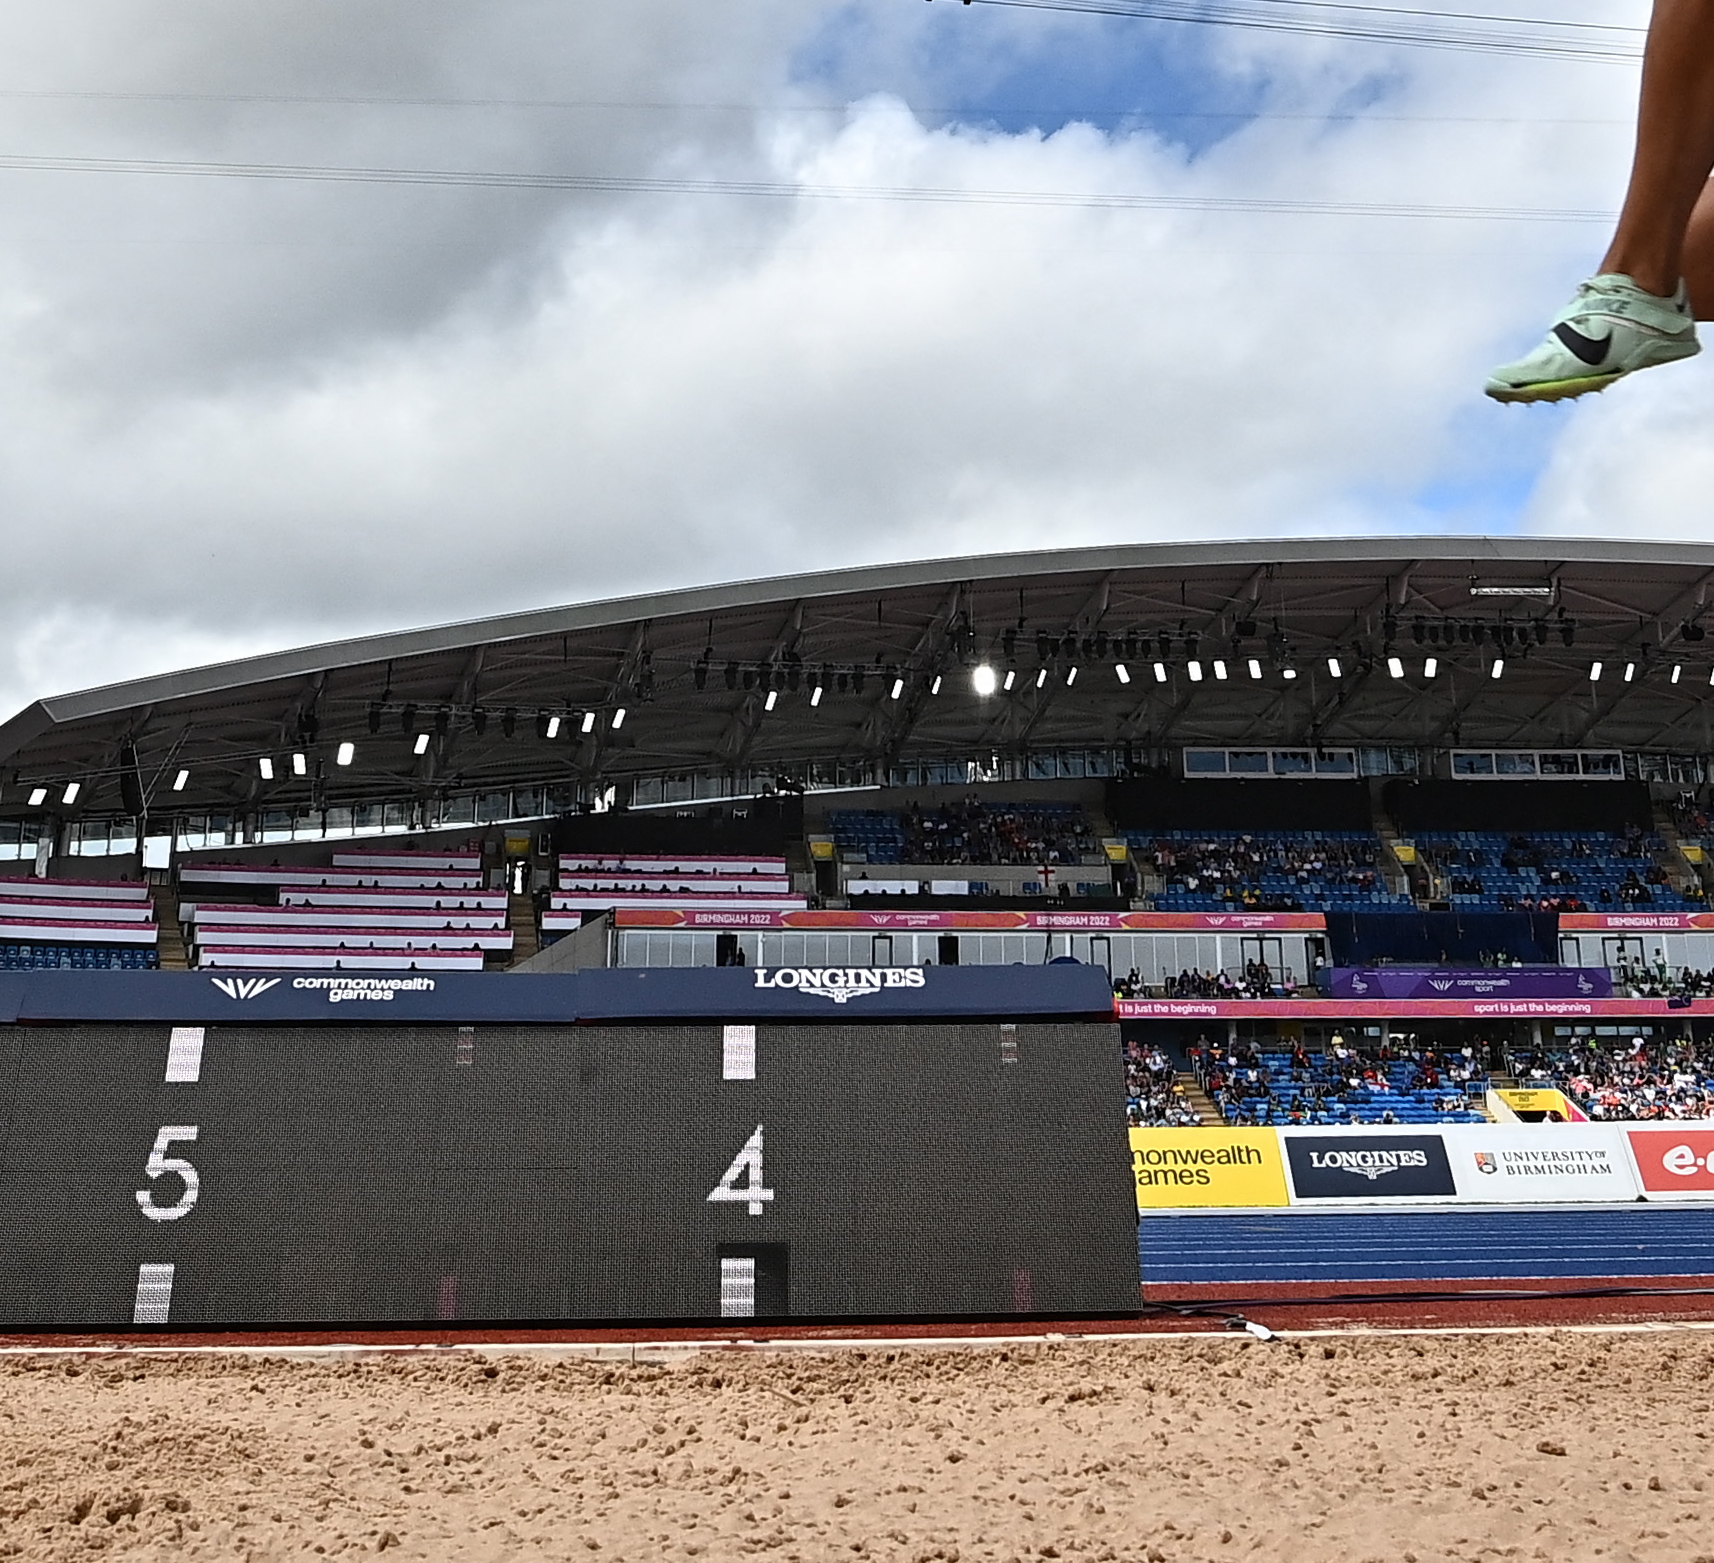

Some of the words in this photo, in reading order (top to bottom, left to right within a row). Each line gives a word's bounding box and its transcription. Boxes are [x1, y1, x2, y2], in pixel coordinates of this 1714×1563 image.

[694, 914, 748, 924] BIRMINGHAM
[749, 913, 771, 924] 2022
[1036, 915, 1087, 925] BIRMINGHAM
[1088, 915, 1110, 926] 2022
[1606, 916, 1658, 927] BIRMINGHAM
[1658, 916, 1679, 927] 2022
[292, 977, 435, 990] commonwealth
[754, 968, 926, 988] LONGINES
[328, 988, 394, 1003] games
[1124, 1004, 1133, 1013] is
[1134, 1004, 1153, 1014] just
[1153, 1004, 1169, 1013] the
[1170, 1003, 1217, 1014] beginning
[1473, 1003, 1499, 1014] sport
[1500, 1003, 1509, 1012] is
[1509, 1003, 1527, 1014] just
[1528, 1003, 1544, 1012] the
[1544, 1002, 1591, 1014] beginning
[1309, 1150, 1428, 1168] LONGINES
[1502, 1150, 1594, 1162] UNIVERSITY
[135, 1125, 200, 1222] 5
[706, 1124, 775, 1215] 4
[1506, 1163, 1613, 1175] BIRMINGHAM
[1137, 1168, 1211, 1186] ames
